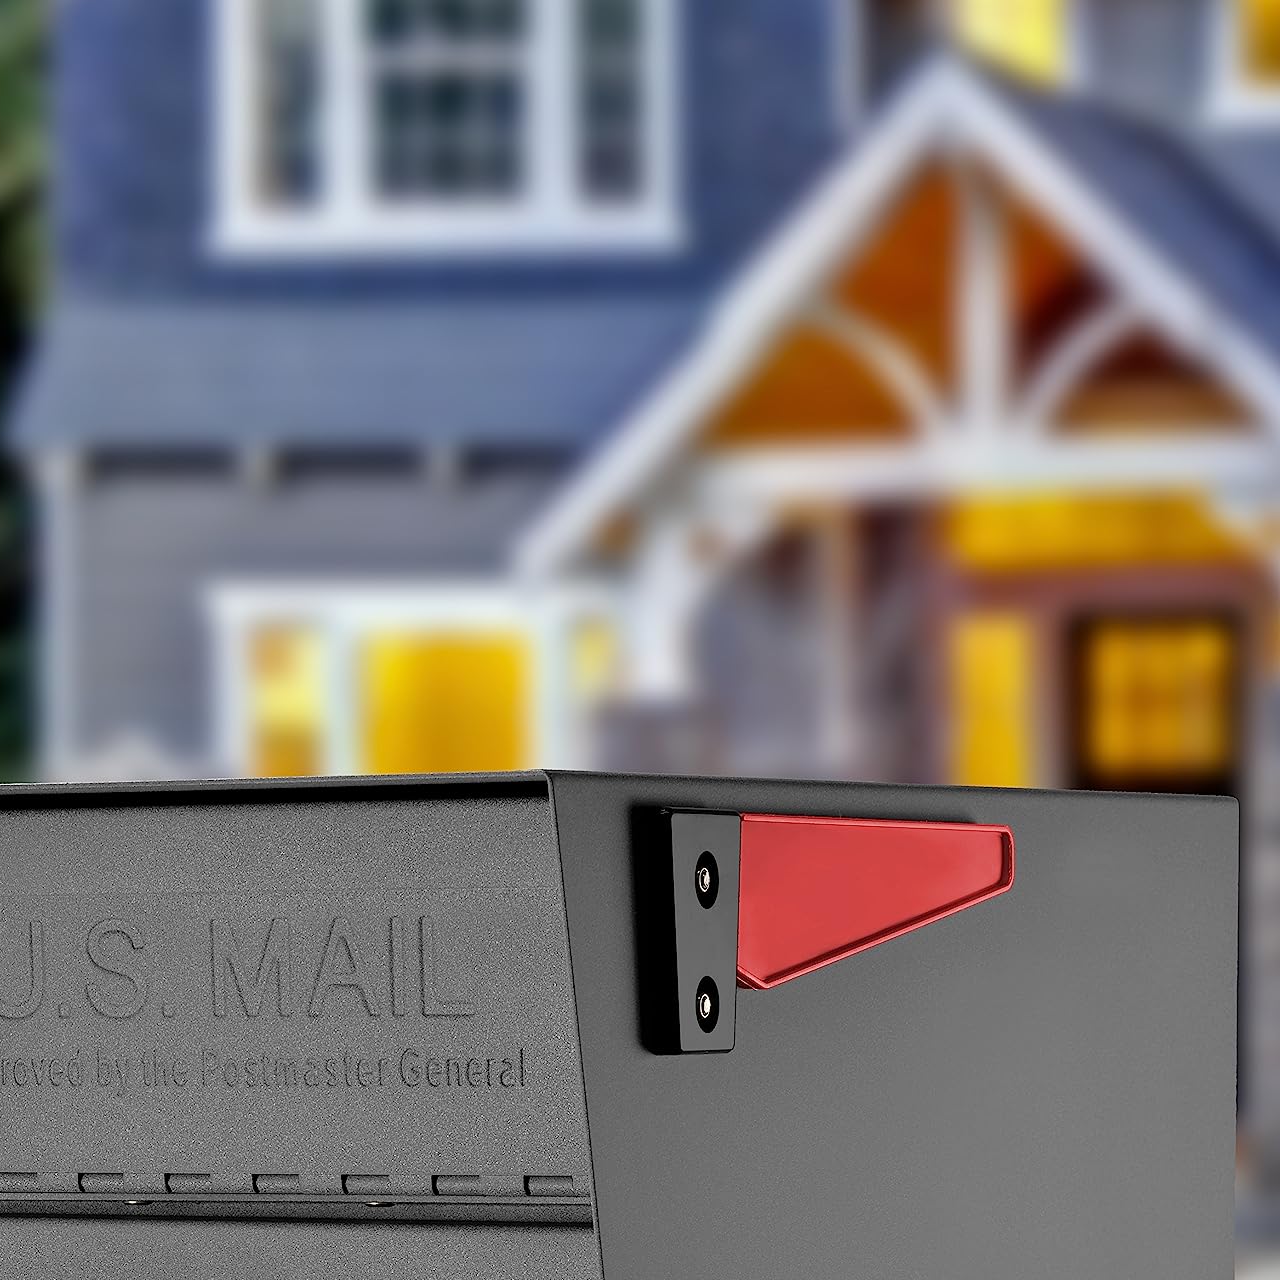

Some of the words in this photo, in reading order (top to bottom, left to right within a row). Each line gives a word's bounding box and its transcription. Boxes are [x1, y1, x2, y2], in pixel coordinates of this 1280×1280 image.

[210, 914, 476, 1017] MAIL
[96, 1049, 128, 1097] by
[140, 1049, 188, 1087] the
[201, 1049, 391, 1088] Postmaster
[399, 1047, 526, 1088] General
